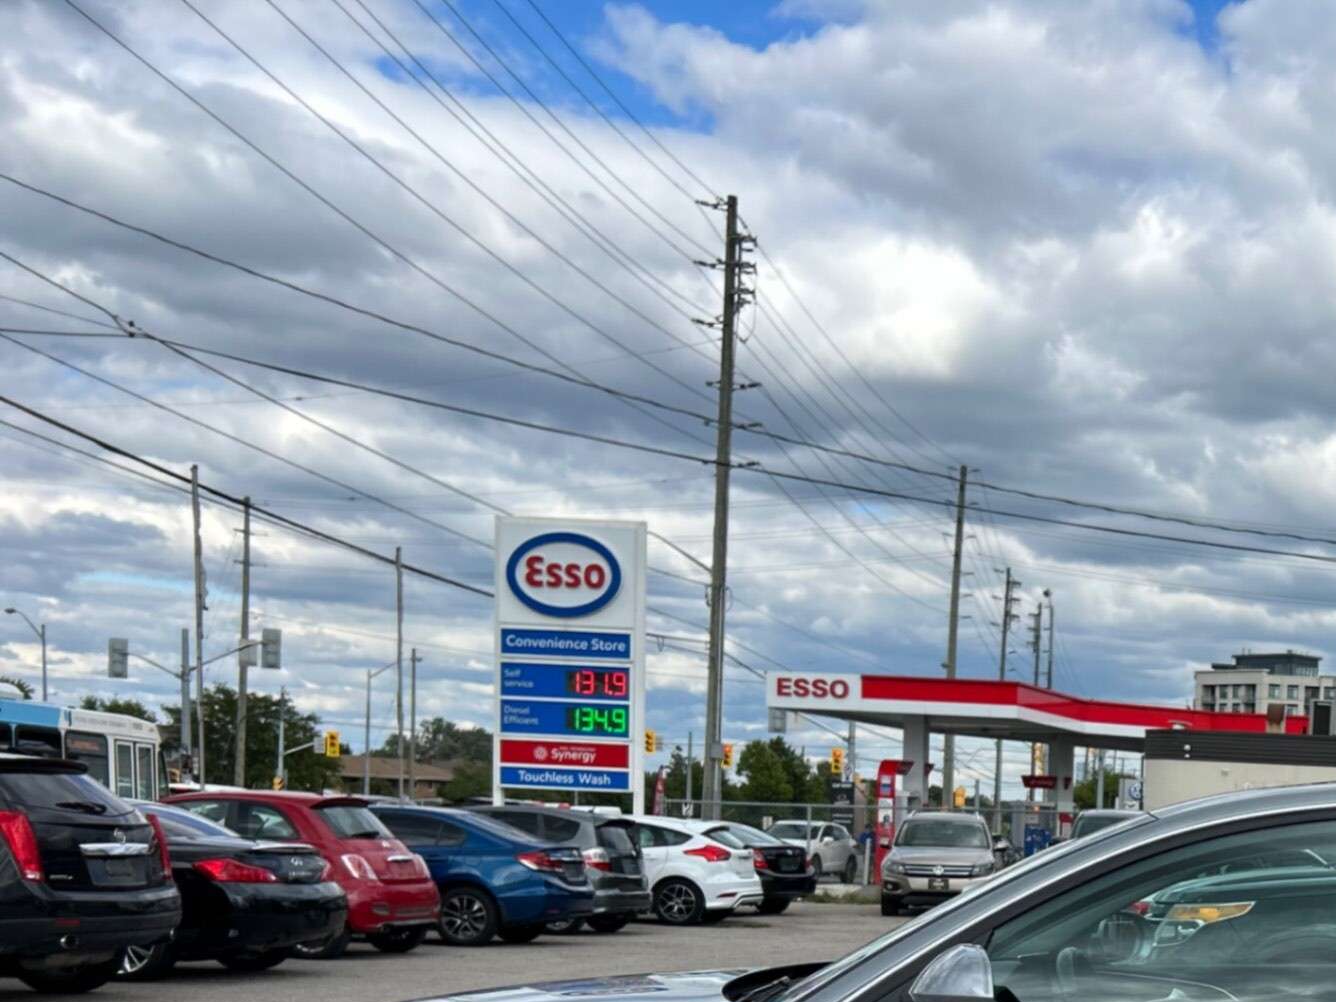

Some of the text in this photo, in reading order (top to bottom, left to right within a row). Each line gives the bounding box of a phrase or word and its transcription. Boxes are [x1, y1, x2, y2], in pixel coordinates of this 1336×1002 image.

[505, 634, 626, 652] Convenience Store
[575, 670, 626, 696] 131.9
[776, 676, 850, 699] ESSO
[503, 704, 531, 715] Diesel
[575, 707, 626, 733] 134.9
[551, 747, 597, 763] Synergy
[518, 769, 612, 786] Touchless Wash
